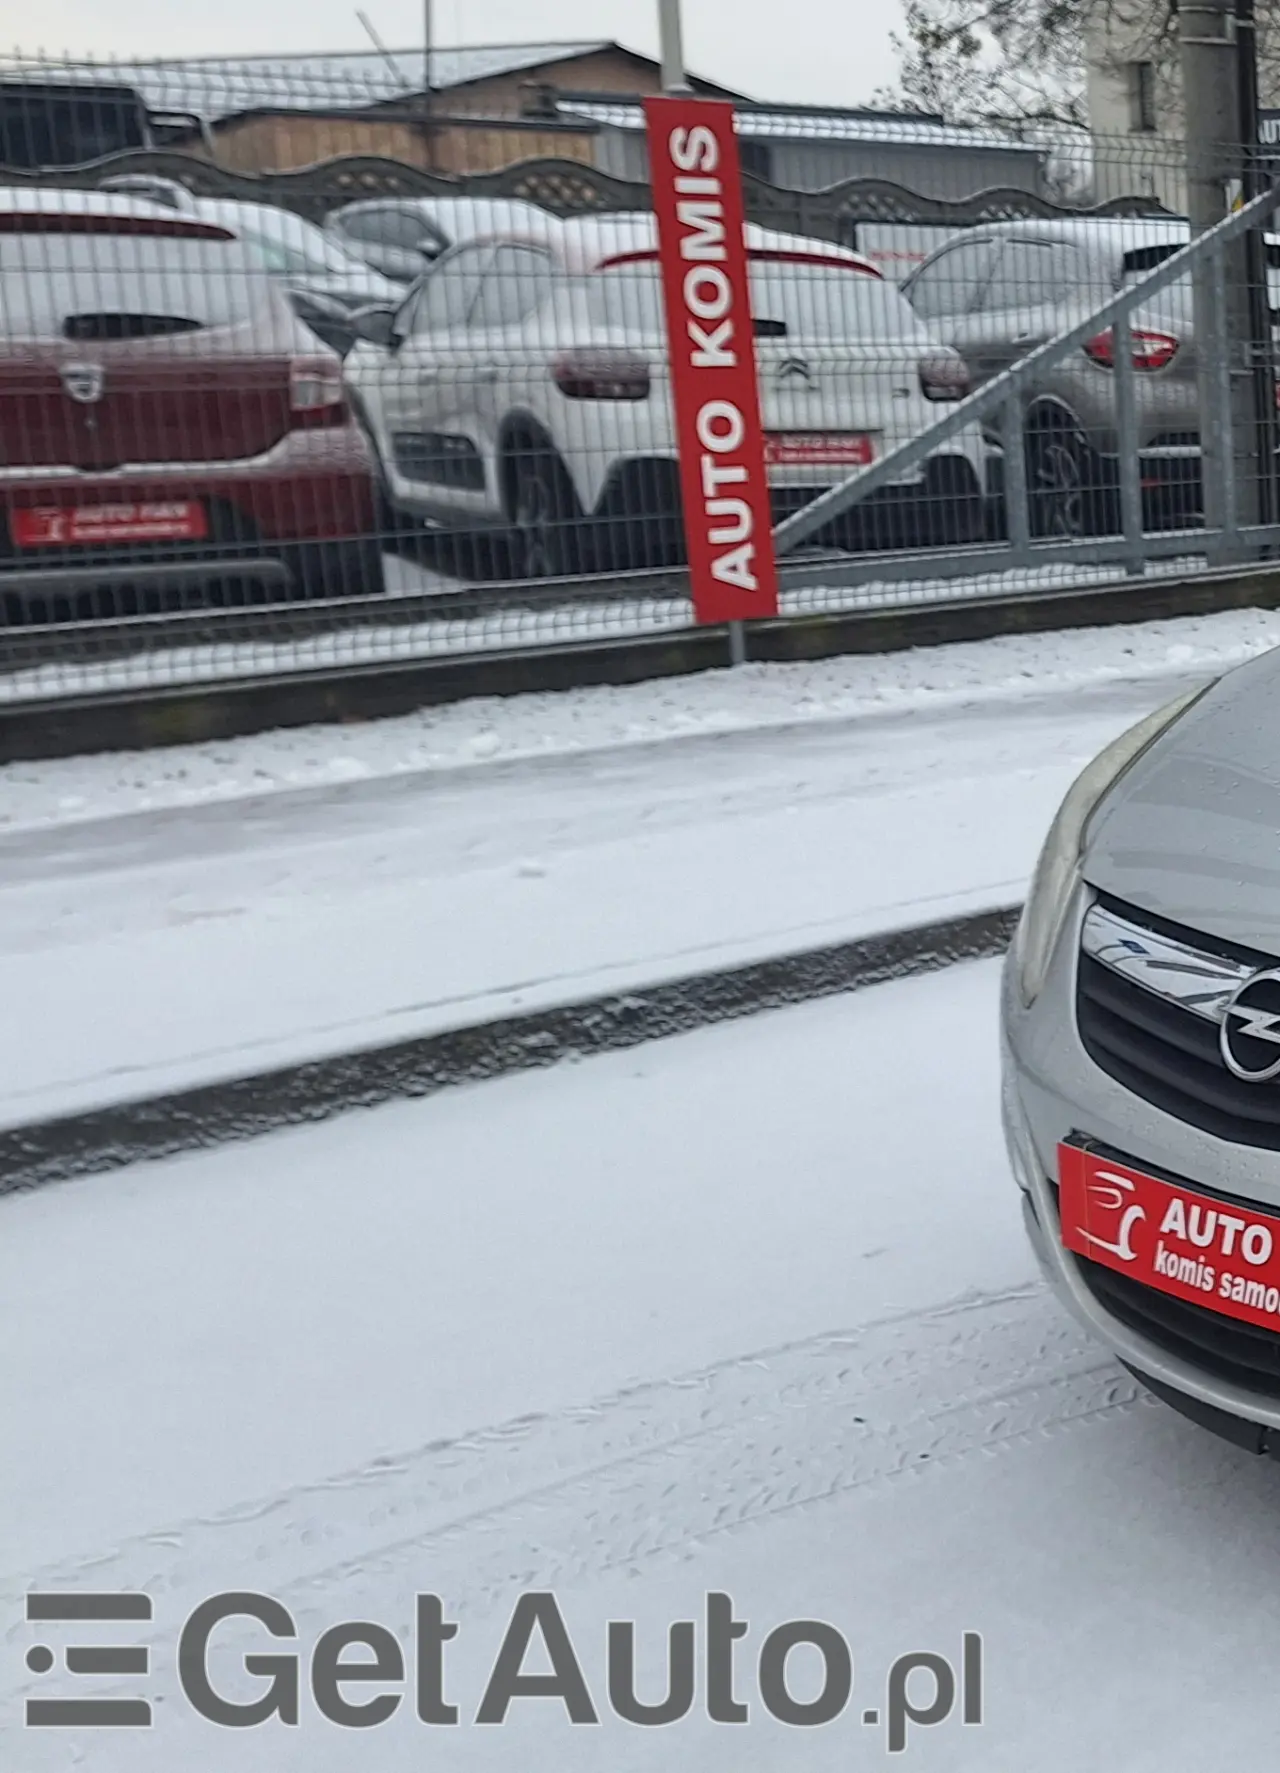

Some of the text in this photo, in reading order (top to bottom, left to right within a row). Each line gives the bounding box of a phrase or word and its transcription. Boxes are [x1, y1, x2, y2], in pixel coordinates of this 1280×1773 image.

[669, 124, 758, 593] AUTO KOMIS
[1155, 1239, 1216, 1292] komis
[1160, 1197, 1273, 1266] AUTO
